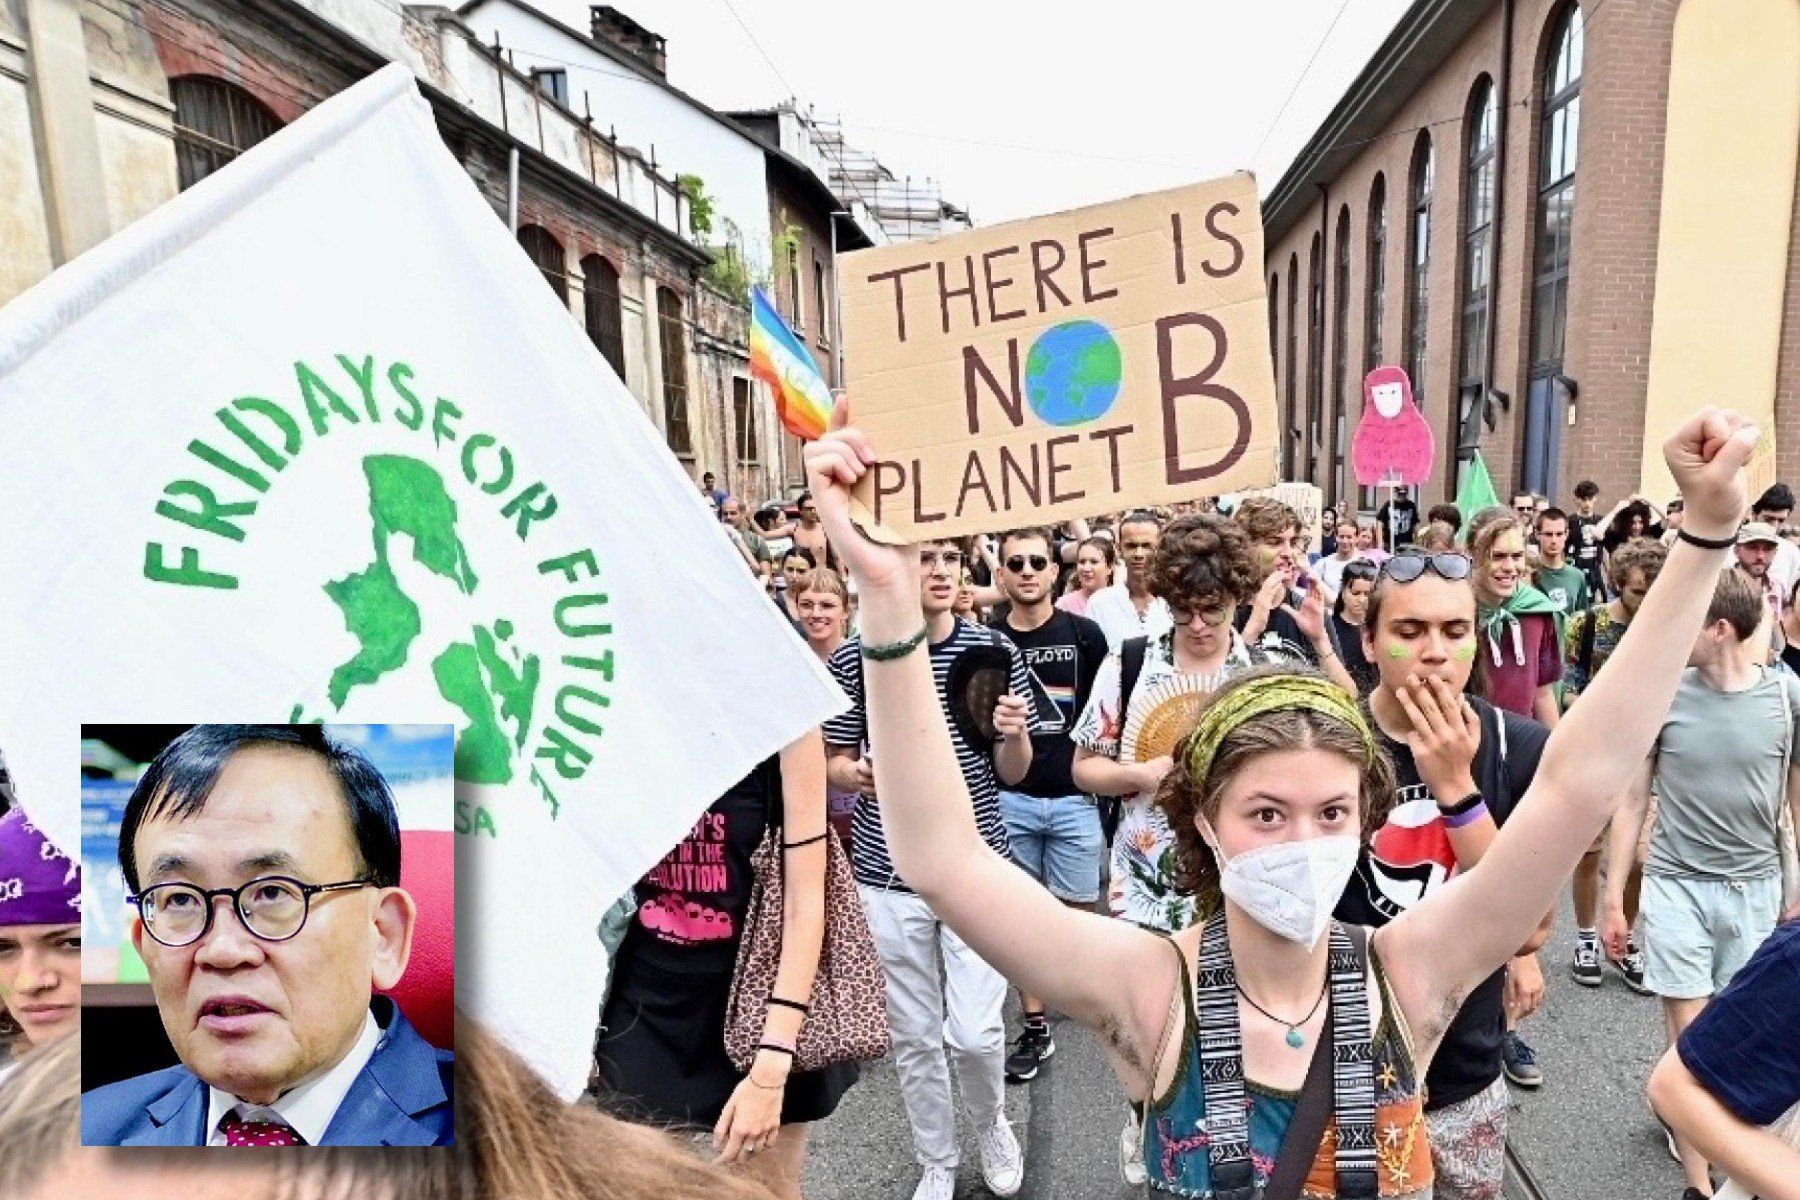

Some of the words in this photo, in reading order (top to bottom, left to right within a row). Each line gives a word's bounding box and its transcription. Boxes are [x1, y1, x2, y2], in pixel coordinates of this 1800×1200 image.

[867, 227, 1118, 343] THERE
[1171, 202, 1244, 285] IS
[873, 425, 1134, 526] PLANET
[1155, 312, 1252, 486] B
[143, 354, 424, 590] FRIDAYS
[432, 398, 559, 541] FOR
[1025, 649, 1074, 664] FLOYD
[454, 801, 496, 838] SA
[697, 843, 725, 862] THE
